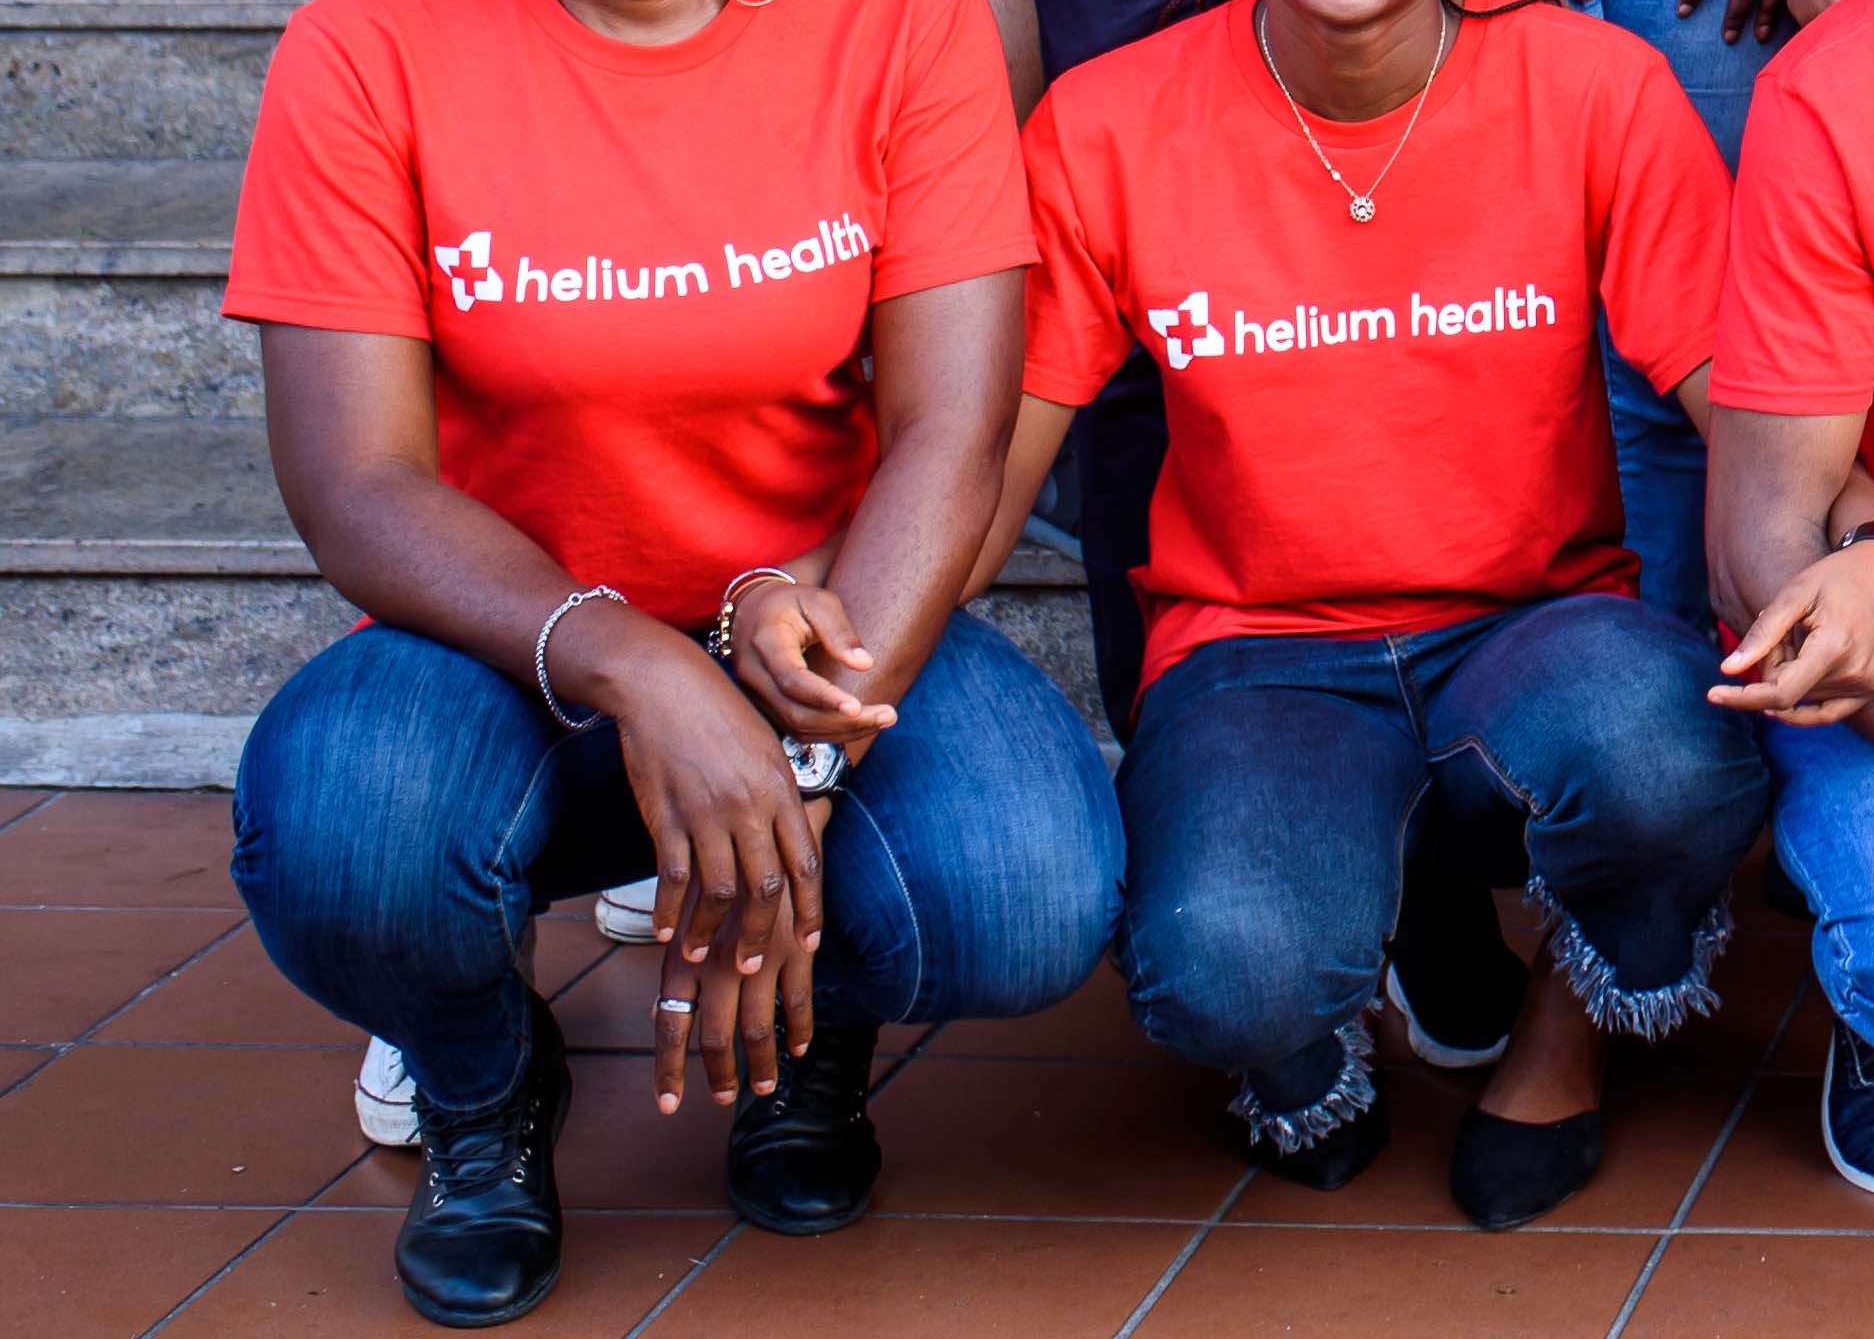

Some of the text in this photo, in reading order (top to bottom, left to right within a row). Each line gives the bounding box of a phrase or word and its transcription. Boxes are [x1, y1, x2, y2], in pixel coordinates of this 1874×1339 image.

[514, 211, 871, 304] helium health
[1234, 283, 1556, 356] helium health
